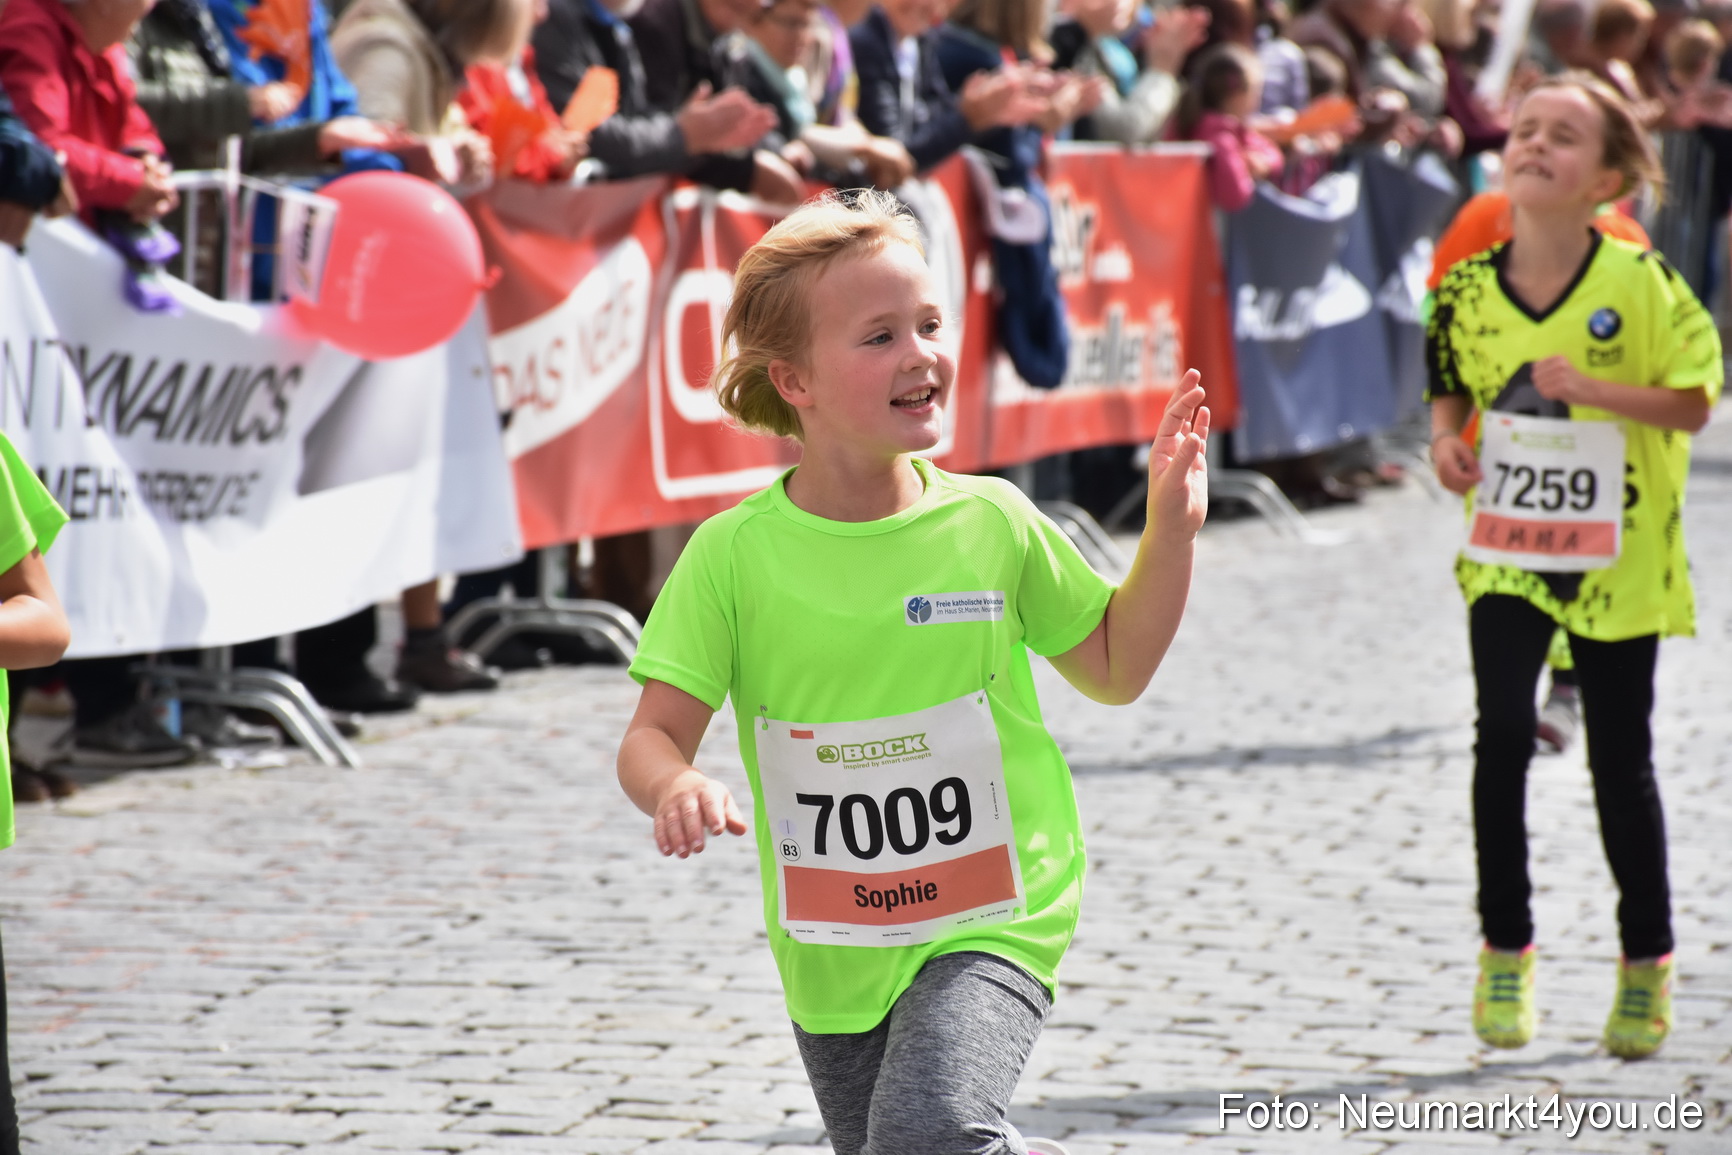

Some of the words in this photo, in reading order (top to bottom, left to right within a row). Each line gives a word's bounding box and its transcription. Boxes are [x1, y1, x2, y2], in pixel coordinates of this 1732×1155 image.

[1493, 461, 1599, 513] 7259
[952, 598, 982, 606] katholische
[841, 733, 930, 763] BOCK
[843, 761, 870, 770] inspired
[871, 760, 880, 768] by
[881, 757, 901, 765] smart
[902, 752, 932, 762] concepts
[796, 776, 972, 860] 7009
[783, 844, 798, 857] B3
[853, 880, 938, 912] Sophie
